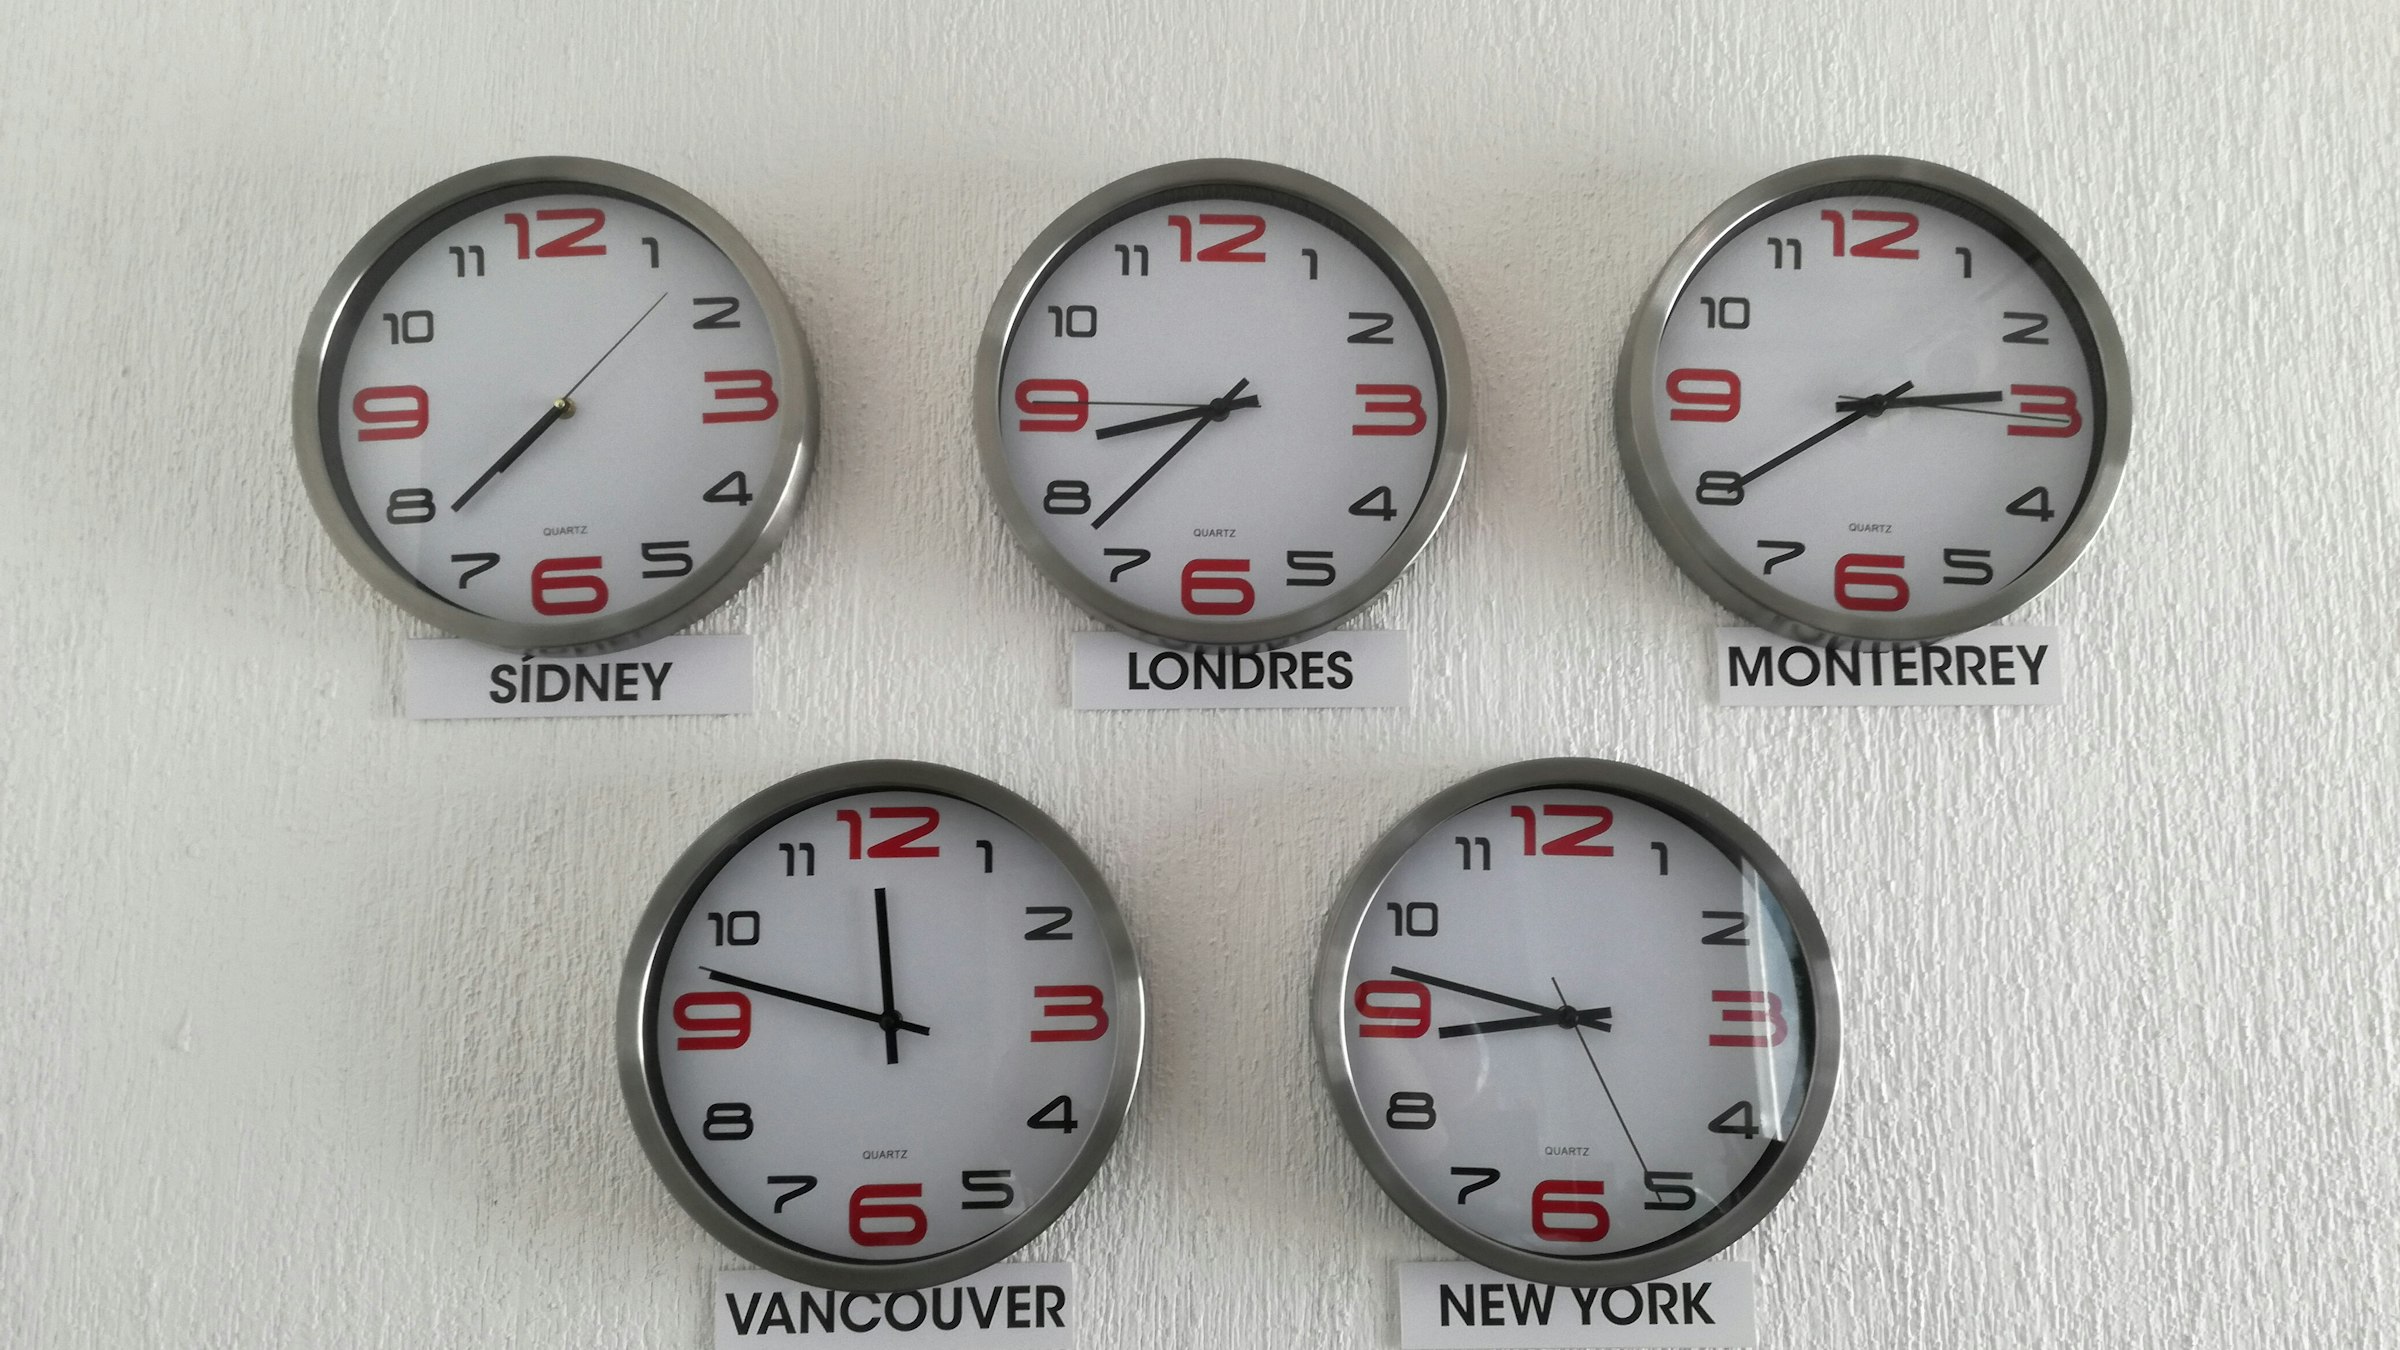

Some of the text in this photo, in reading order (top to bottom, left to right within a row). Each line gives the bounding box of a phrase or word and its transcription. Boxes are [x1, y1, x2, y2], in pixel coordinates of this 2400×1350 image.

[504, 208, 606, 259] 12
[1168, 214, 1266, 263] 12
[1821, 209, 1919, 259] 12
[449, 245, 485, 278] 11
[642, 237, 659, 268] 1
[1115, 244, 1149, 276] 11
[1302, 249, 1318, 280] 1
[1768, 237, 1802, 270] 11
[1956, 247, 1972, 278] 1
[383, 310, 433, 345] 10
[693, 296, 740, 330] 2
[1048, 305, 1097, 338] 10
[1347, 312, 1394, 344] 2
[1700, 296, 1750, 330] 10
[2002, 311, 2049, 345] 2
[352, 385, 429, 442] 9
[702, 369, 778, 424] 3
[1015, 378, 1088, 432] 9
[1352, 384, 1427, 436] 3
[1666, 368, 1741, 422] 9
[2007, 384, 2082, 438] 3
[386, 488, 436, 525] 8
[703, 471, 753, 506] 4
[1043, 480, 1091, 515] 8
[1348, 486, 1397, 521] 4
[1696, 470, 1745, 506] 8
[2006, 486, 2055, 522] 4
[543, 526, 588, 536] QUARTZ
[1193, 528, 1236, 538] QUARTZ
[1848, 522, 1892, 534] QUARTZ
[451, 552, 500, 589] 7
[641, 541, 692, 579] 5
[1103, 548, 1151, 582] 7
[1286, 550, 1336, 587] 5
[1757, 540, 1805, 575] 7
[1943, 548, 1993, 585] 5
[531, 556, 609, 616] 6
[1181, 558, 1255, 616] 6
[1834, 553, 1910, 612] 6
[1128, 651, 1353, 691] LONDRES
[1729, 645, 2048, 687] MONTERREY
[837, 807, 940, 860] 12
[1511, 804, 1614, 857] 12
[779, 842, 814, 877] 11
[976, 840, 993, 873] 1
[1455, 836, 1491, 871] 11
[1651, 841, 1669, 876] 1
[708, 911, 760, 946] 10
[1024, 907, 1073, 940] 2
[1387, 901, 1438, 937] 10
[1701, 910, 1750, 945] 2
[673, 991, 752, 1051] 9
[1030, 985, 1109, 1042] 3
[1354, 980, 1431, 1038] 9
[1708, 990, 1788, 1047] 3
[703, 1102, 754, 1141] 8
[1027, 1095, 1078, 1133] 4
[1386, 1092, 1436, 1130] 8
[1708, 1101, 1759, 1140] 4
[862, 1149, 908, 1161] QUARTZ
[1544, 1146, 1589, 1157] QUARTZ
[767, 1175, 818, 1214] 7
[961, 1170, 1014, 1209] 5
[1451, 1167, 1500, 1205] 7
[1644, 1171, 1696, 1210] 5
[849, 1183, 927, 1247] 6
[1532, 1180, 1610, 1242] 6
[725, 1285, 1066, 1335] VANCOUVER
[1440, 1282, 1716, 1327] NEW YORK
